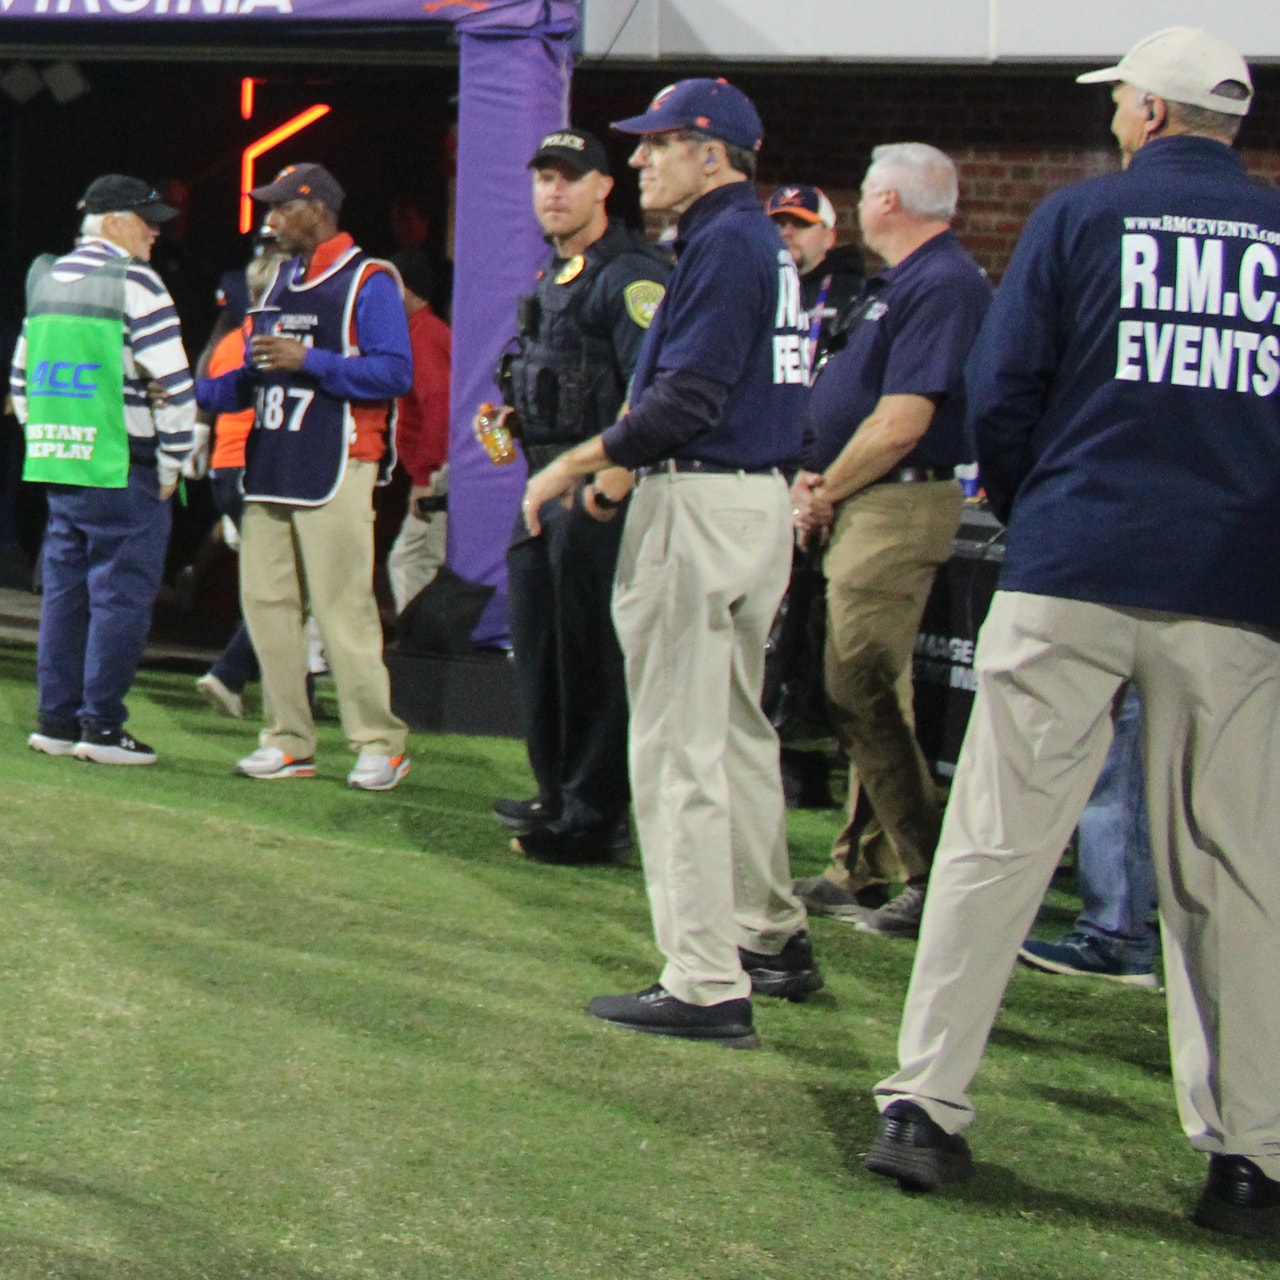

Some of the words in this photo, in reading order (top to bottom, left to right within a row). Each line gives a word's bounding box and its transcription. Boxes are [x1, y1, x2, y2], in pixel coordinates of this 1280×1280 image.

[1114, 320, 1280, 397] EVENTS
[30, 359, 102, 391] ACC
[26, 441, 95, 461] EPLAY
